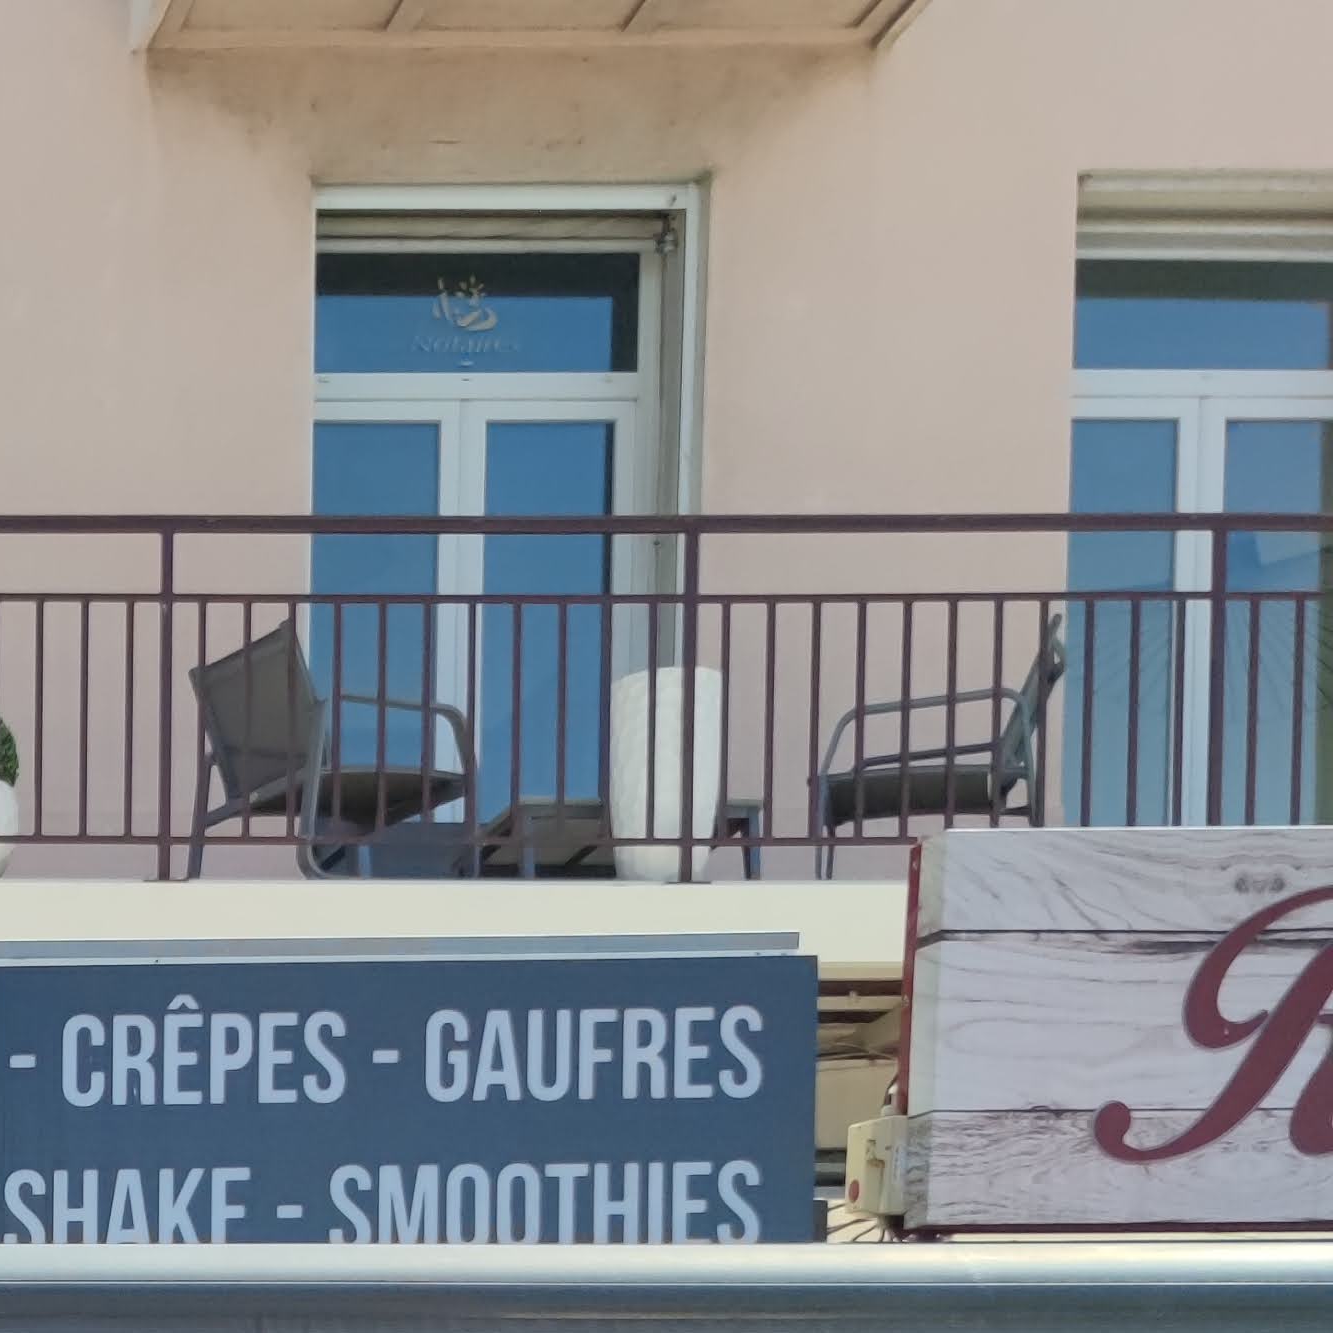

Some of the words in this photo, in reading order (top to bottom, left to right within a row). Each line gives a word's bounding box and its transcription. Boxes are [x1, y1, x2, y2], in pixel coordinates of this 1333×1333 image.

[62, 994, 346, 1107] CRÊPES
[425, 1005, 762, 1103] GAUFRES
[3, 1166, 251, 1243] SHAKE
[329, 1159, 761, 1243] SMOOTHIES
